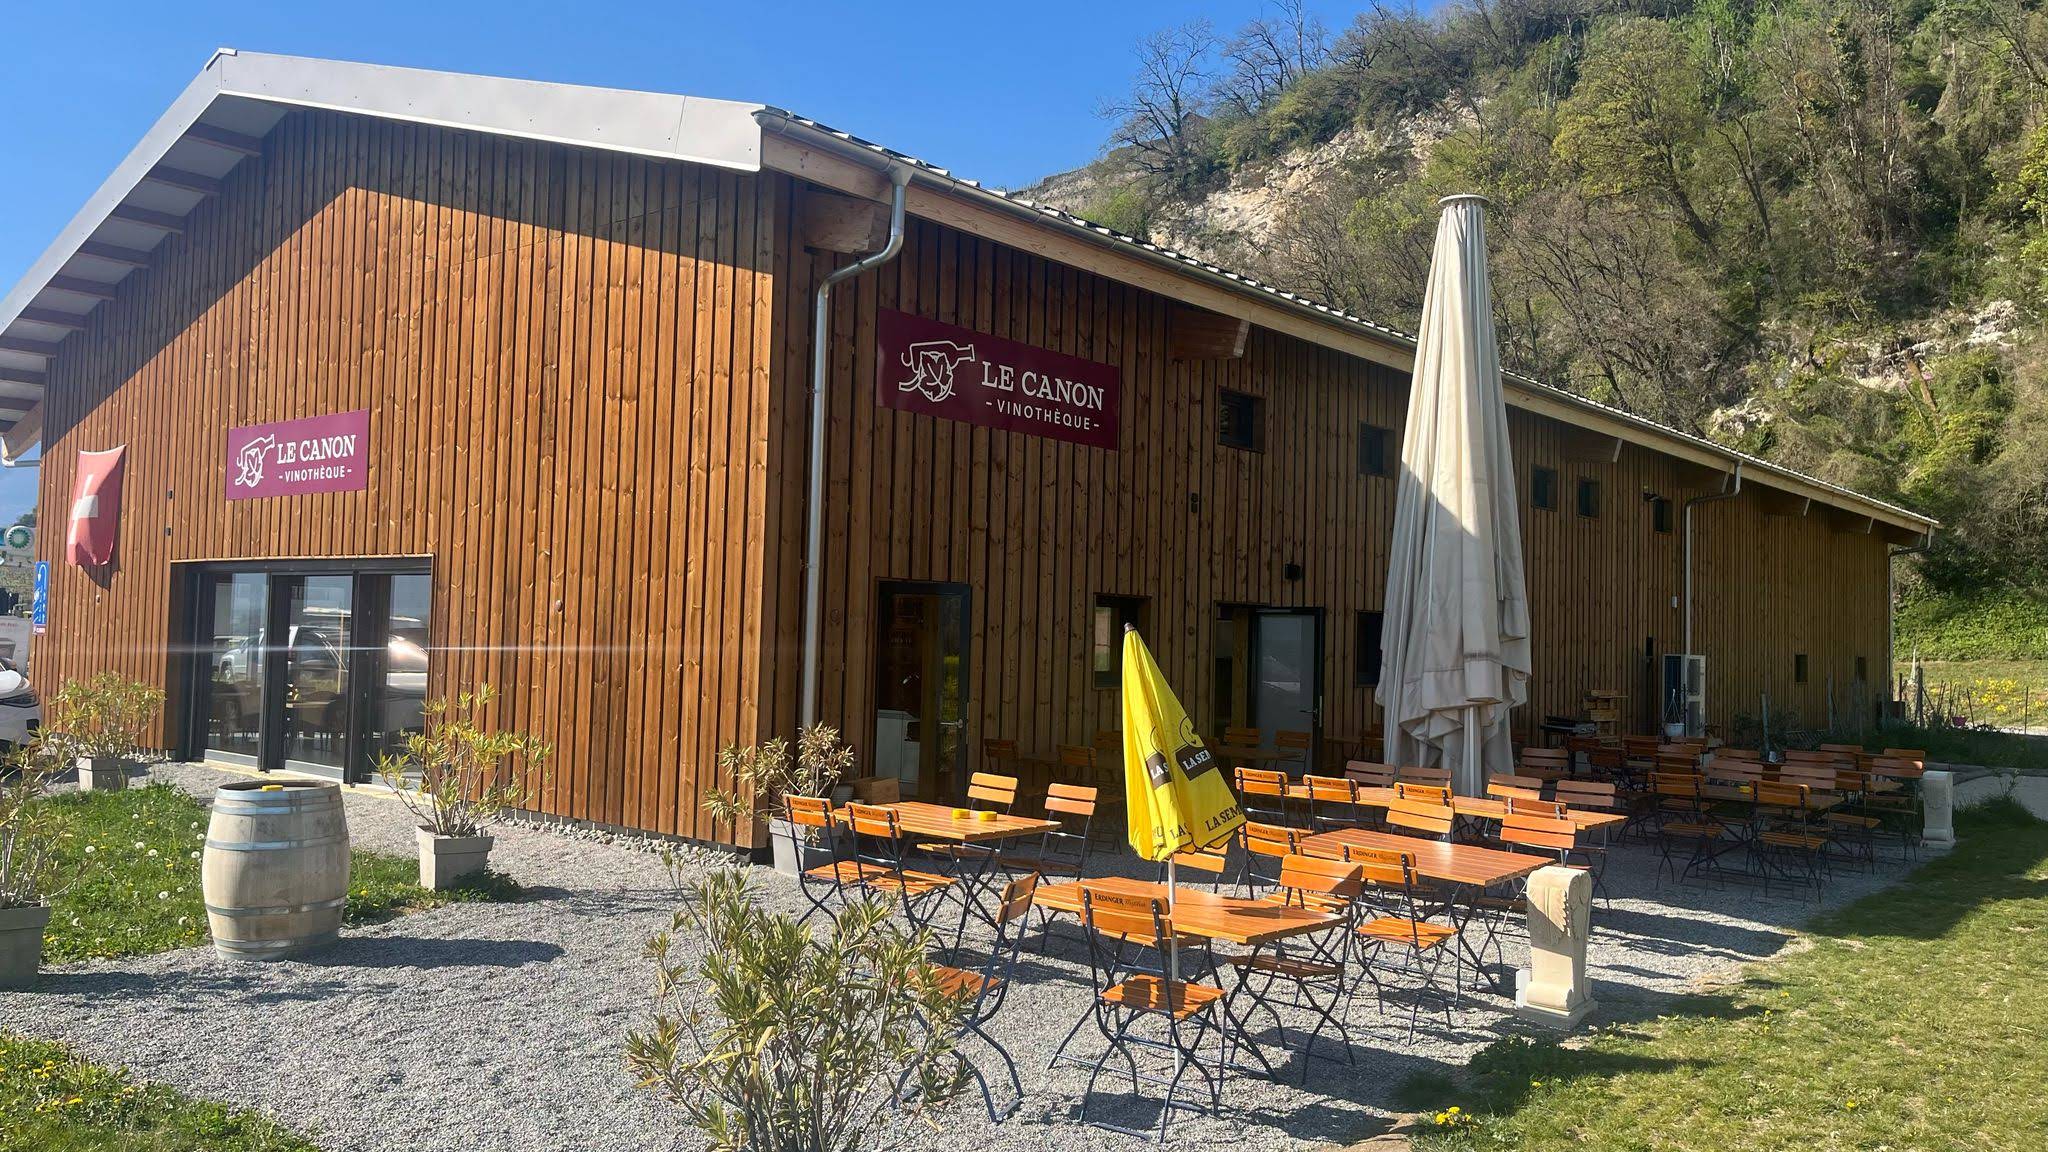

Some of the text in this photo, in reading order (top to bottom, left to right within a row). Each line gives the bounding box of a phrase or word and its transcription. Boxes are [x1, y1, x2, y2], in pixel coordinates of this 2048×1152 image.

[981, 360, 1105, 411] LE CANON
[276, 434, 357, 464] LE CANON
[1182, 756, 1198, 771] LA
[1150, 765, 1164, 779] LA
[1205, 816, 1221, 832] LA
[1094, 893, 1124, 905] ERDINGER
